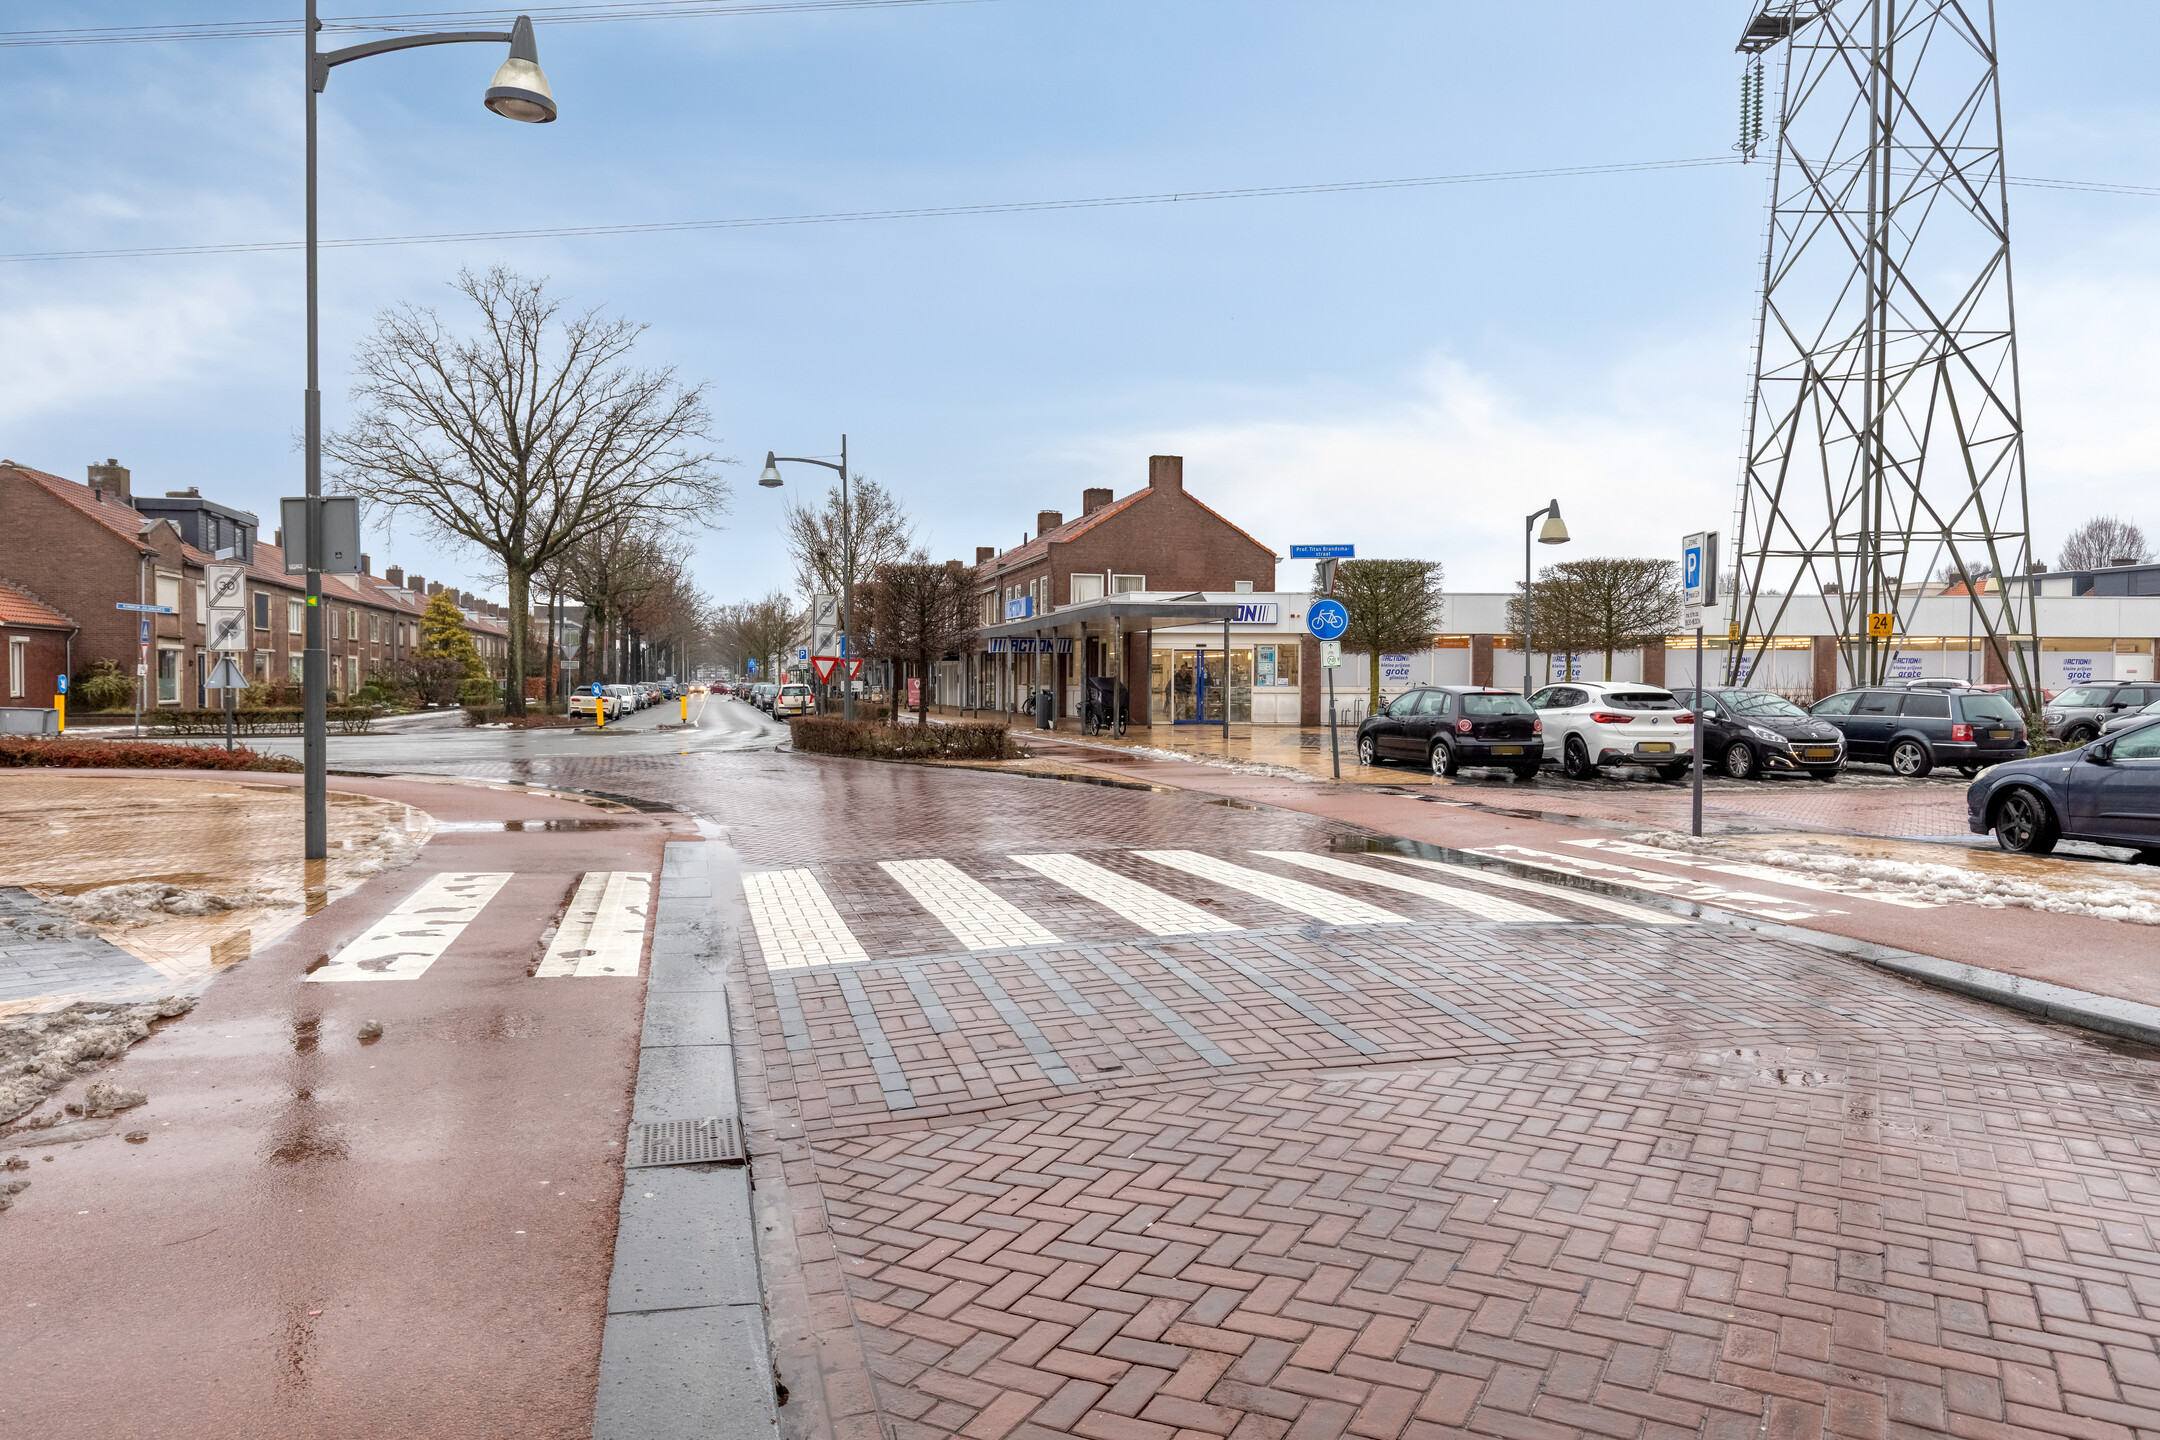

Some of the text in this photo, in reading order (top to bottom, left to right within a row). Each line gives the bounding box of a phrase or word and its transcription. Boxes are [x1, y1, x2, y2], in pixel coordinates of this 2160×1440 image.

[1687, 552, 1697, 584] P
[218, 580, 235, 591] 30
[1873, 616, 1888, 630] 24
[800, 650, 805, 658] P
[1385, 654, 1406, 662] ACTION
[1385, 668, 1410, 676] grote
[1556, 669, 1581, 678] grte
[2067, 671, 2092, 680] grote
